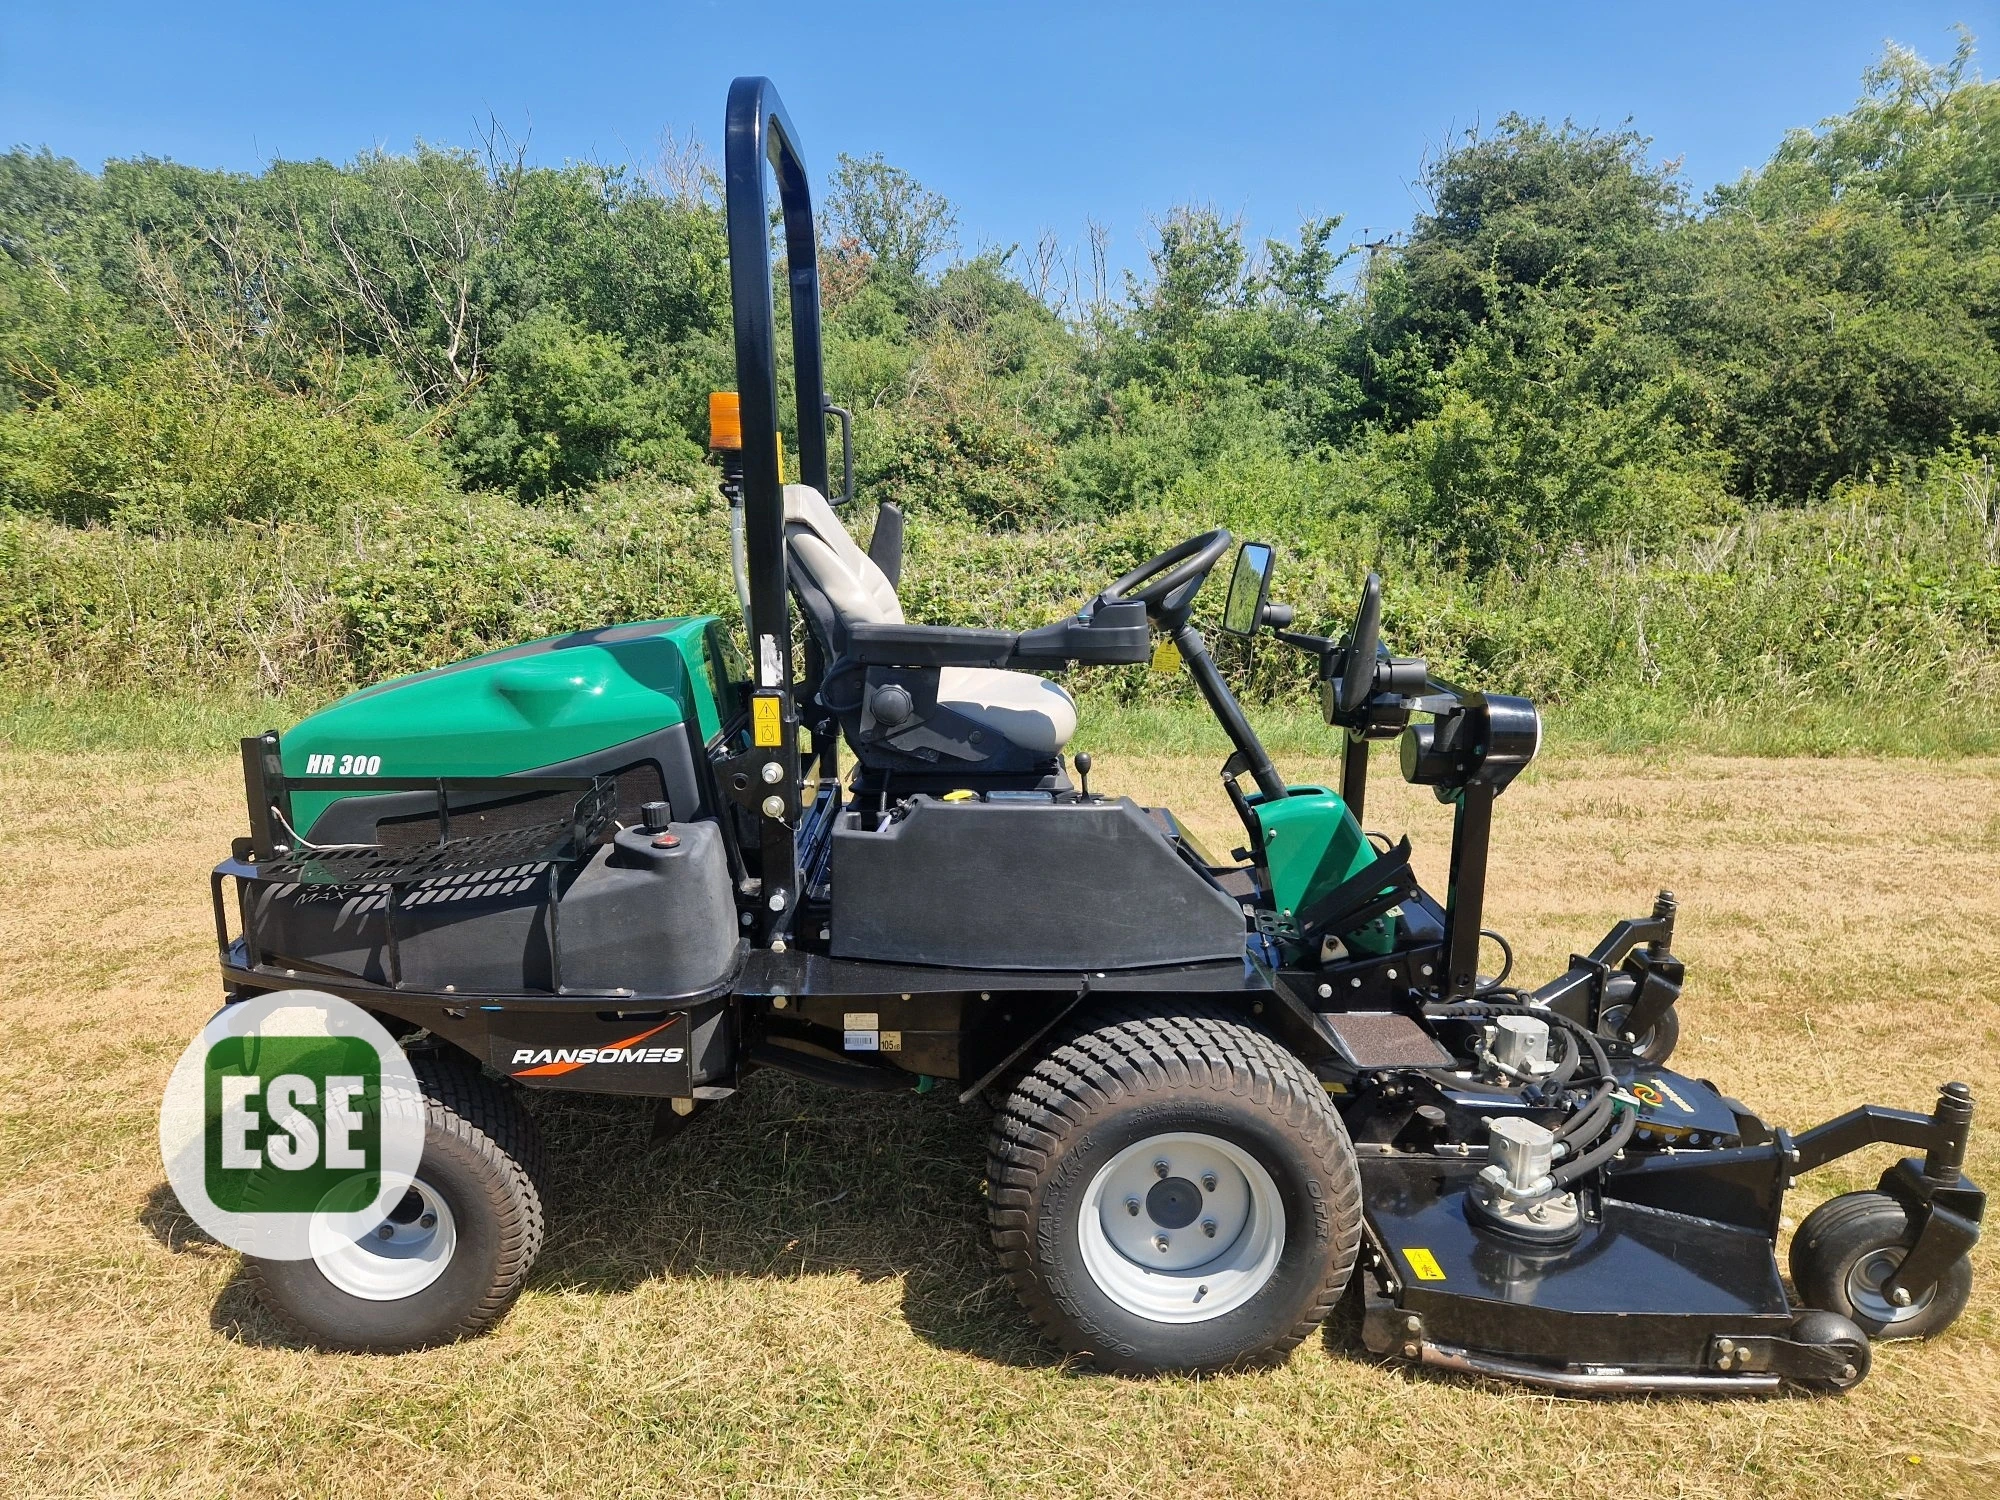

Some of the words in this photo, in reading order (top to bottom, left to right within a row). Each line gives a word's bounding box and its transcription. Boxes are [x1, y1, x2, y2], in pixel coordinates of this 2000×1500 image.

[306, 754, 335, 775] HR
[338, 754, 381, 776] 300
[293, 891, 350, 908] MAX
[881, 1040, 894, 1050] 105
[511, 1048, 684, 1064] RANSOMES
[1306, 1180, 1329, 1238] OTR
